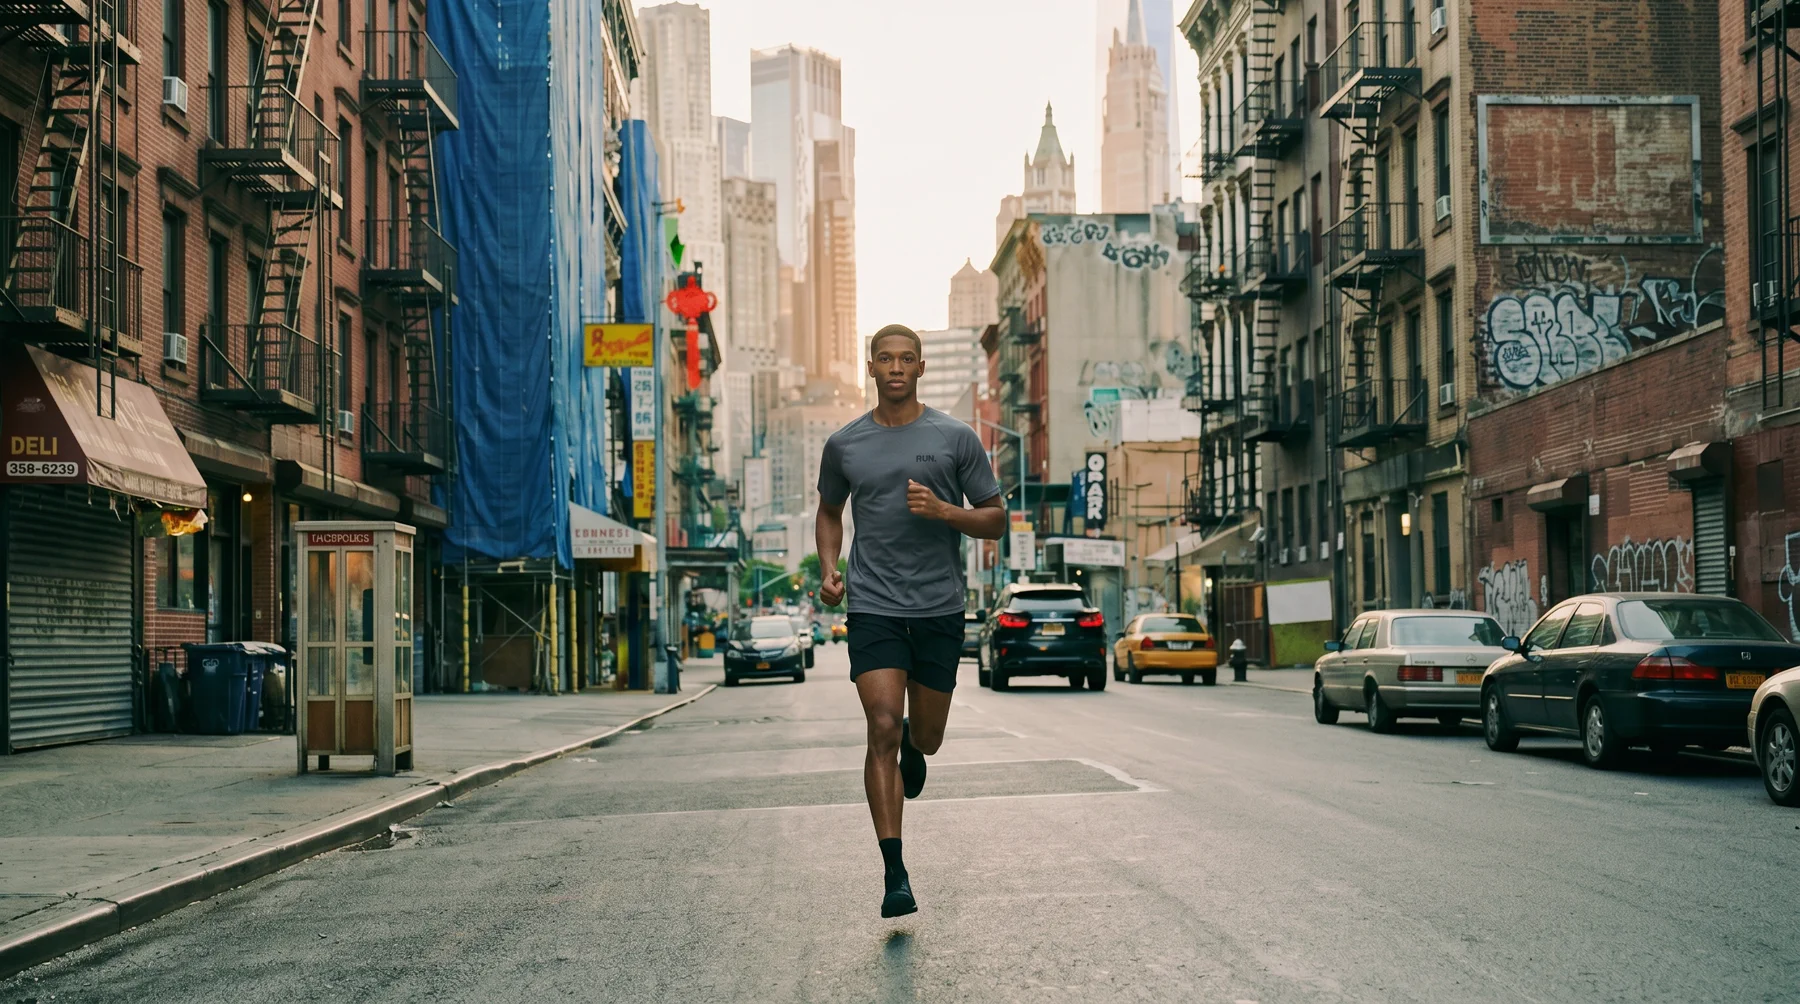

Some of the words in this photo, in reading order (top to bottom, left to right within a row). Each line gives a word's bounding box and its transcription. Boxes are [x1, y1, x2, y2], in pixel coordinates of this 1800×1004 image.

[11, 436, 58, 455] DELI
[916, 454, 937, 463] RUN.
[9, 463, 75, 475] 358-6239
